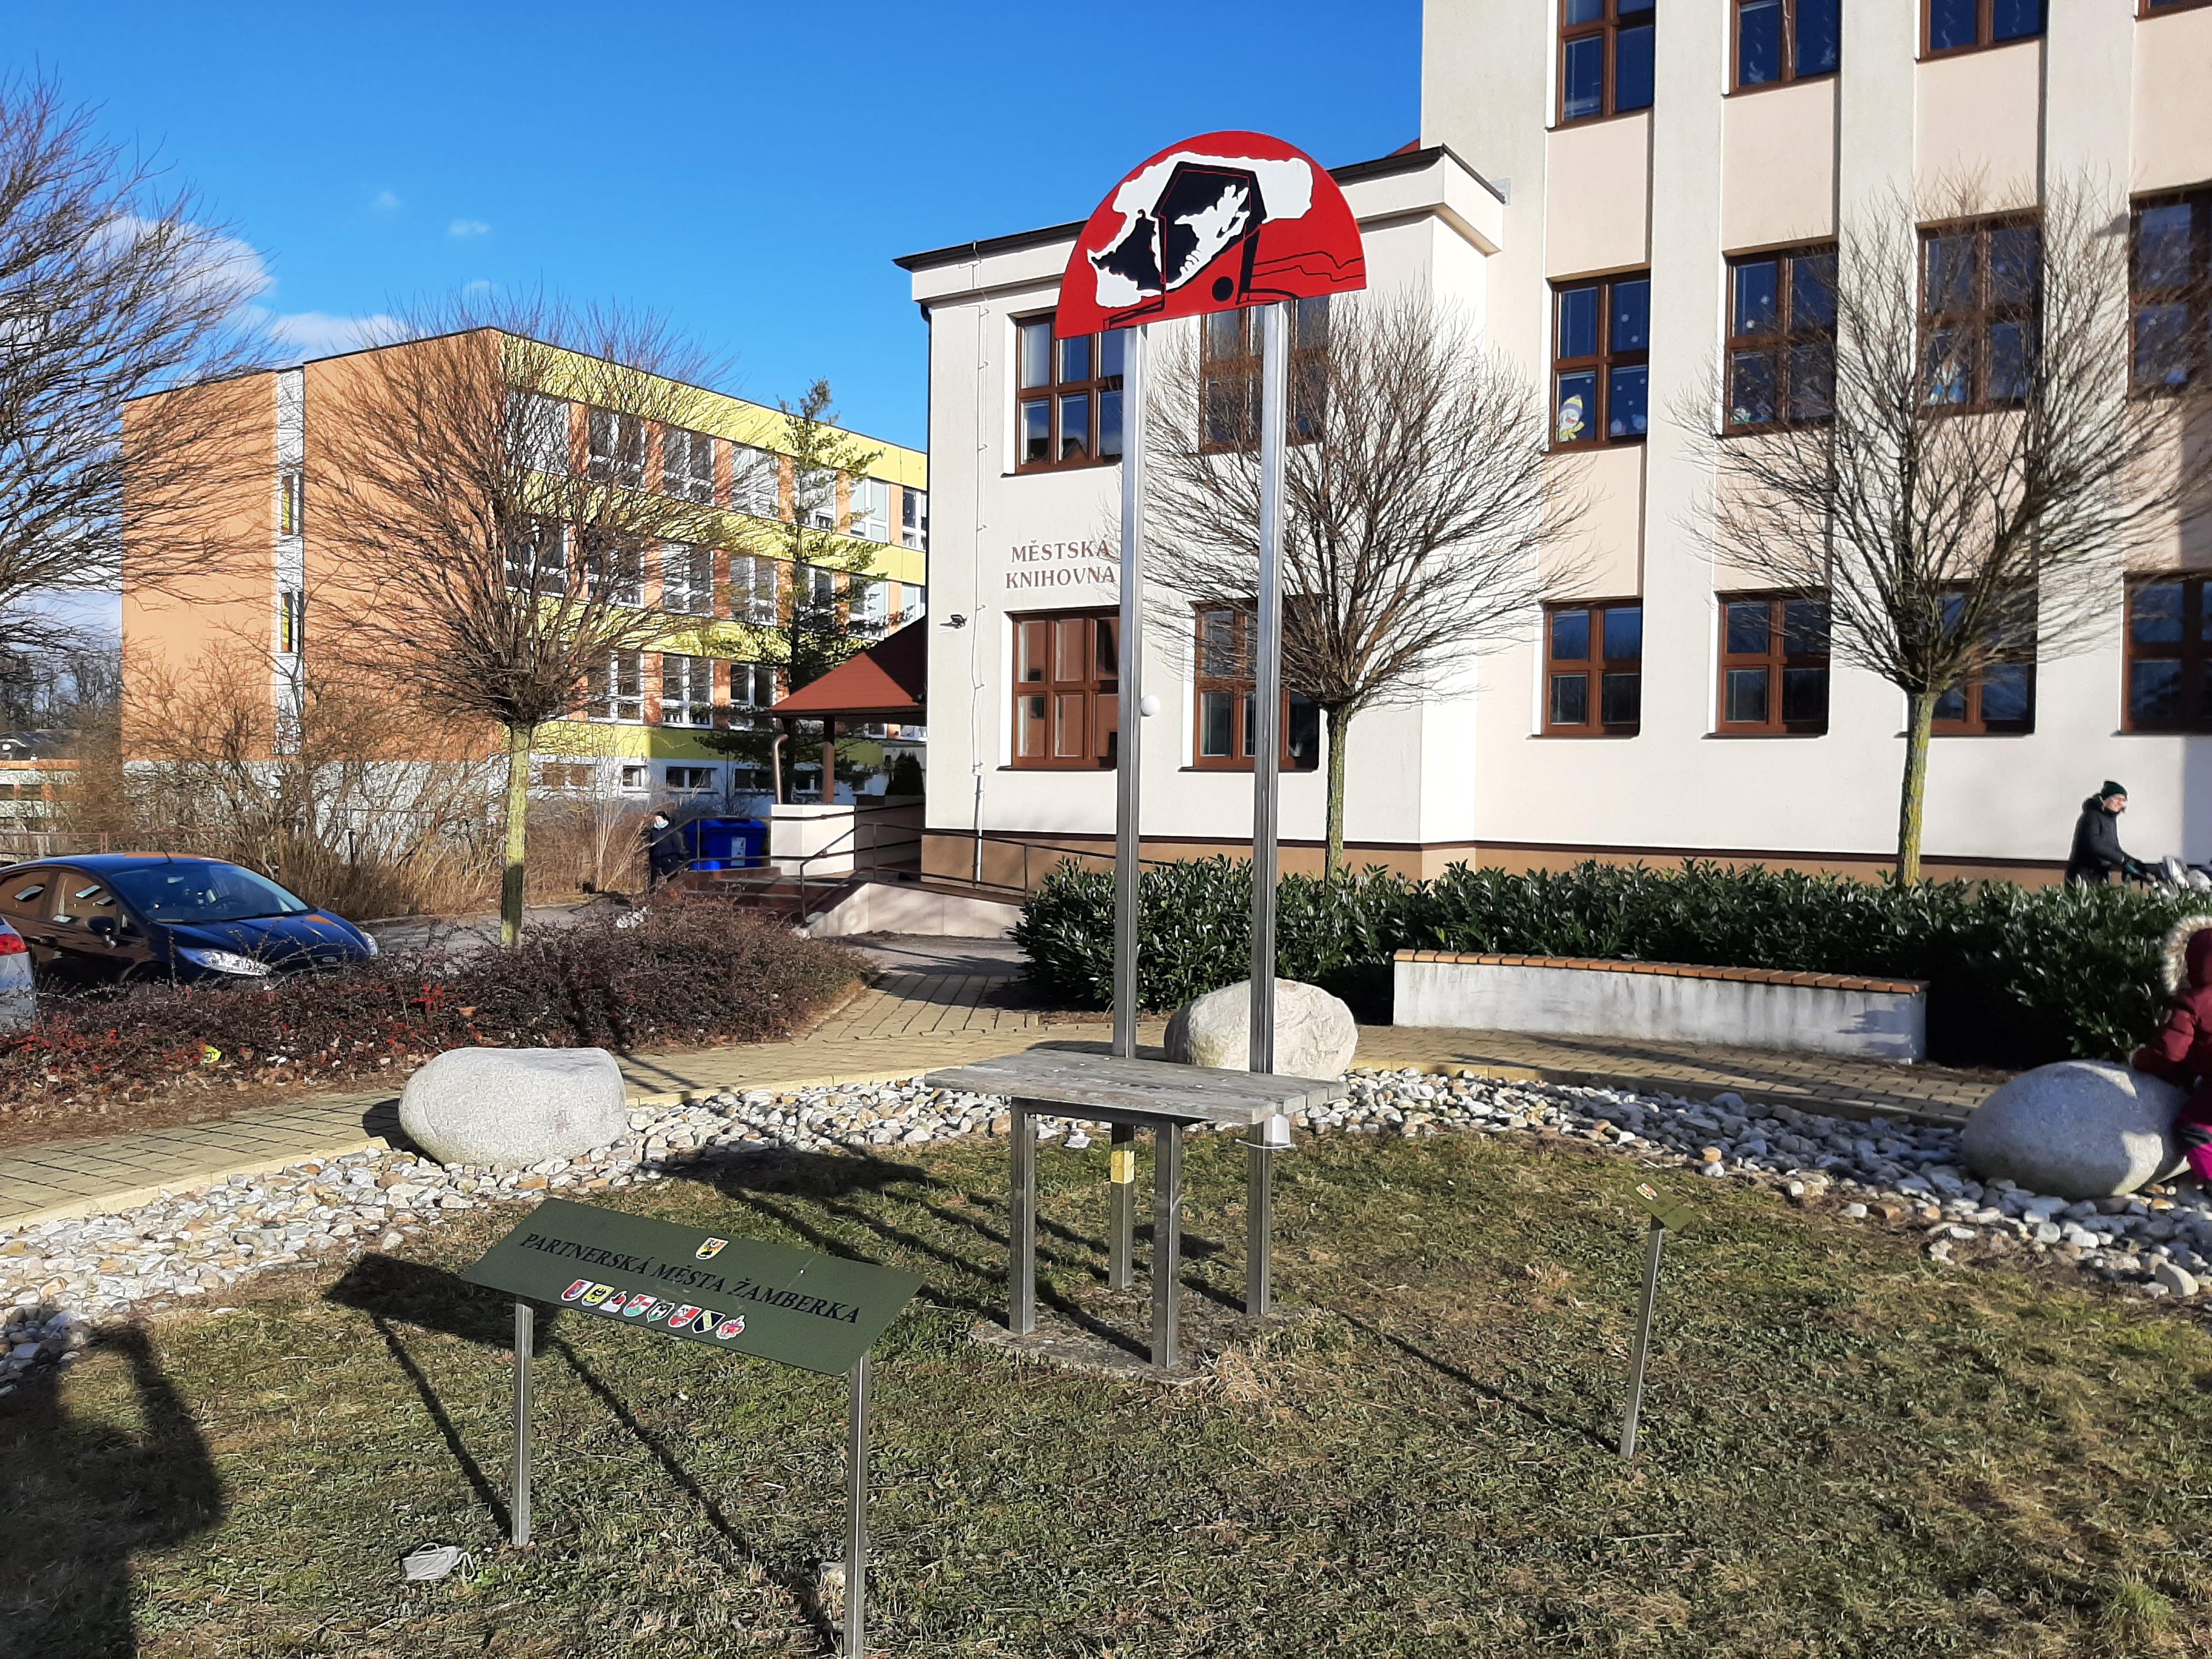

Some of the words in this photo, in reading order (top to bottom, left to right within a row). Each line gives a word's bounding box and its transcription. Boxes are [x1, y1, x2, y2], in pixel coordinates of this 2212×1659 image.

[1005, 566, 1116, 589] KNIHOVNA
[519, 1233, 655, 1275] PARTNERSKÁ
[649, 1263, 726, 1292] MĚSTA
[727, 1277, 860, 1324] ŽAMBERKA
